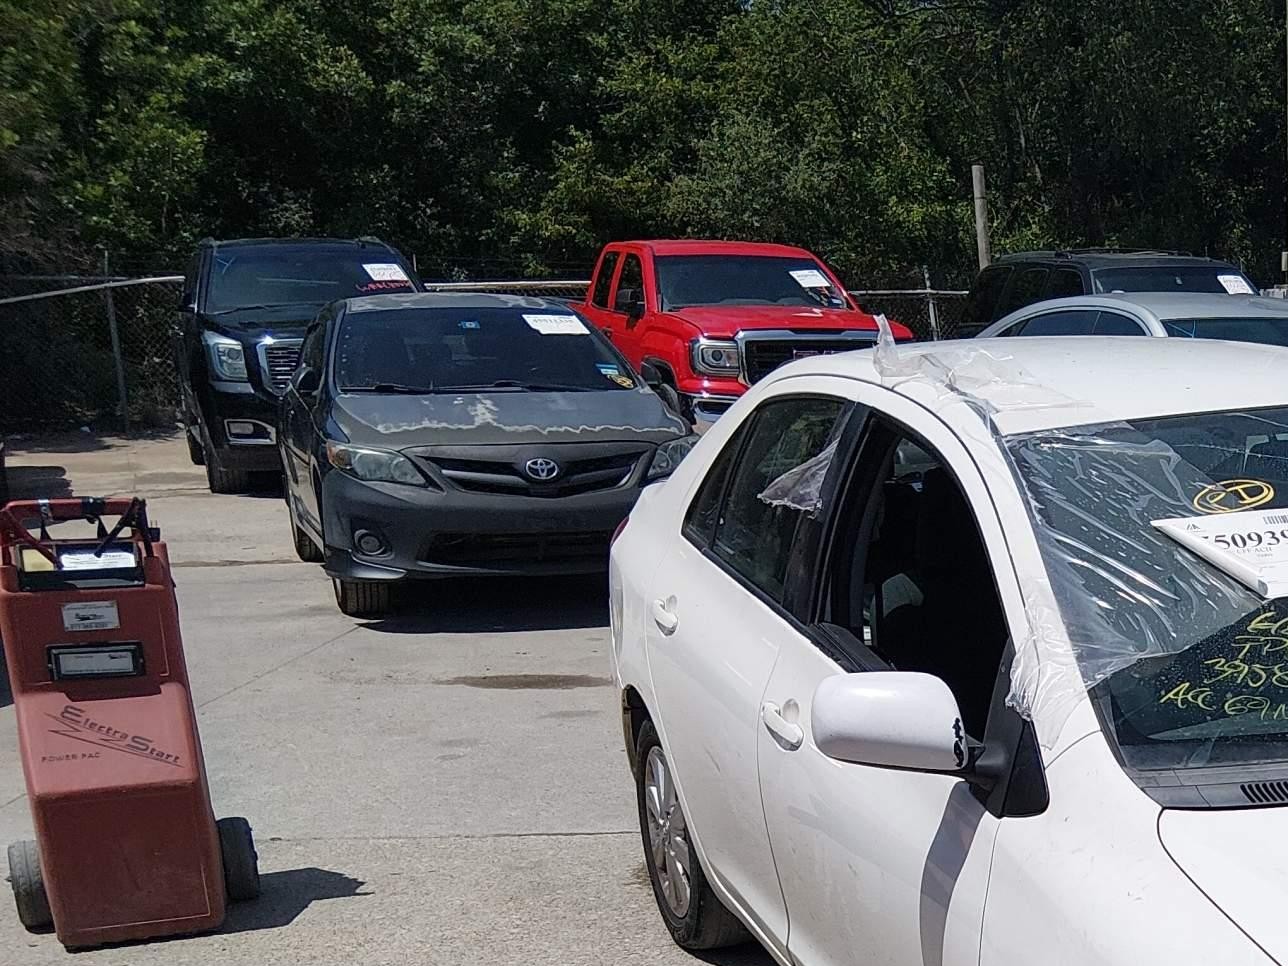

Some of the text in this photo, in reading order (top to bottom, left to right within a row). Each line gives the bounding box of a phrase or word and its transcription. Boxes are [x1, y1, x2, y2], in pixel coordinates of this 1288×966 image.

[41, 752, 101, 763] POWER PAC
[126, 735, 181, 764] Start
